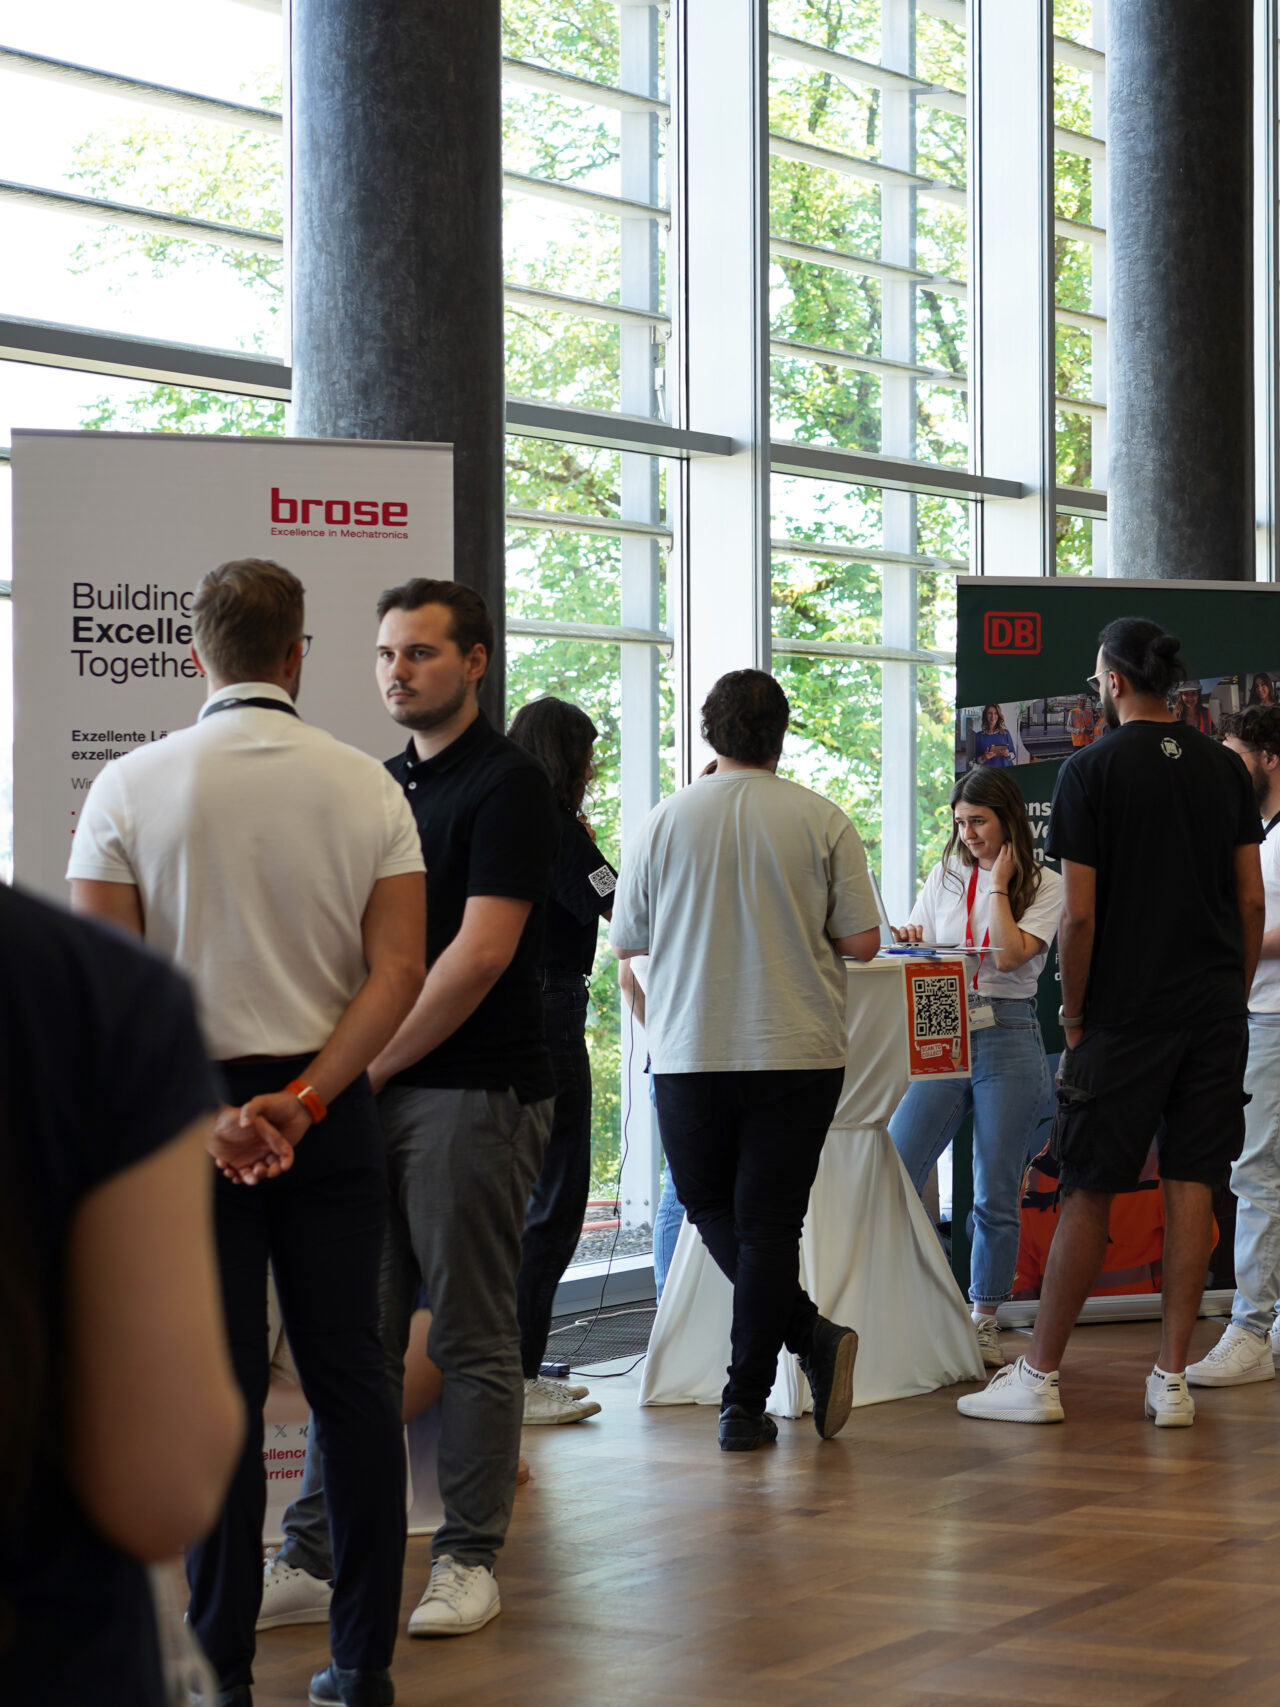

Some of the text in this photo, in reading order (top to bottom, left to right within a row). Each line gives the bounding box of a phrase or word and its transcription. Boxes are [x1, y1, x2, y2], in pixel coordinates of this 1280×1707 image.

[271, 487, 408, 526] brose
[271, 528, 408, 540] Excellence in Mechatronics
[73, 582, 195, 618] Building
[73, 616, 192, 644] Excelle
[992, 618, 1034, 647] DB
[71, 650, 205, 684] Togethe
[72, 730, 168, 742] Exzellente Lö
[1023, 1365, 1045, 1380] adida
[262, 1448, 306, 1461] ellence
